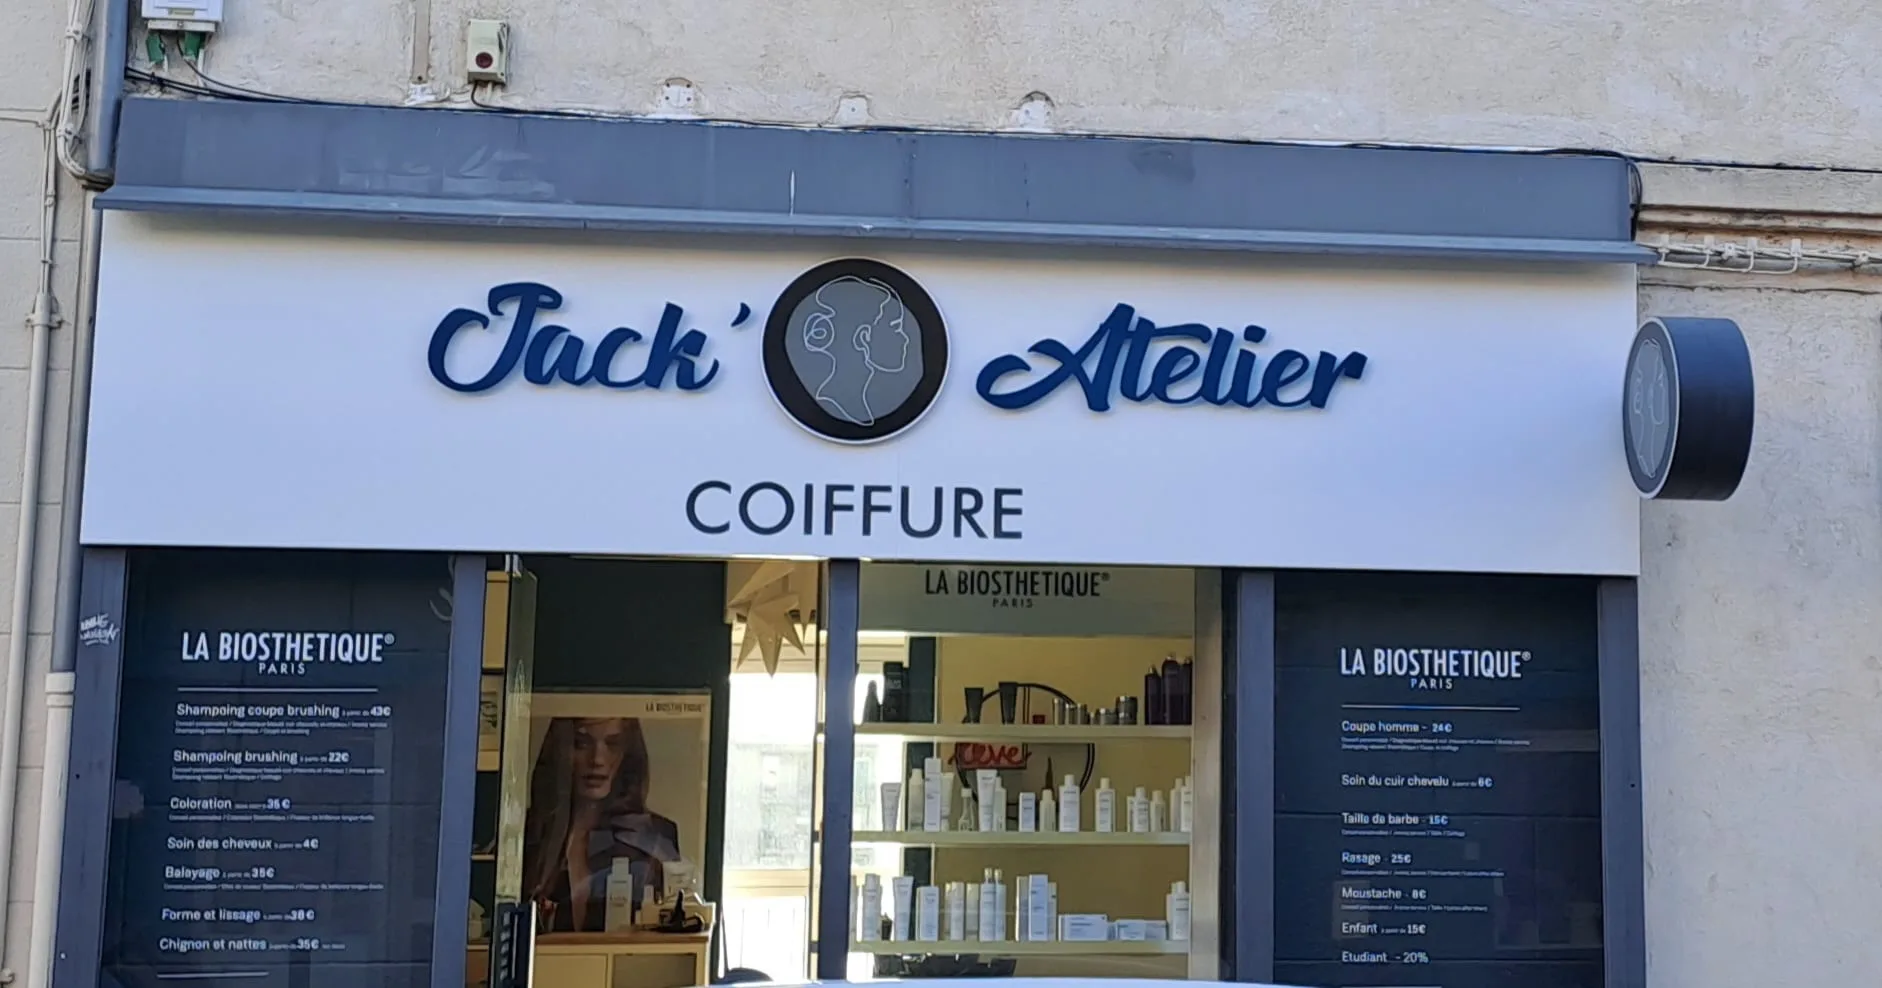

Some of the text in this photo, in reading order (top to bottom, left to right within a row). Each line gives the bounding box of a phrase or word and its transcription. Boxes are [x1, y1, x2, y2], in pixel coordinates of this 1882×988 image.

[975, 302, 1367, 414] Atelier
[686, 480, 1024, 540] COIFFURE
[925, 569, 949, 595] LA
[992, 598, 1033, 608] PARIS
[181, 632, 210, 660] LA
[258, 662, 306, 675] PARIS
[1341, 648, 1366, 675] LA
[1410, 678, 1453, 689] PARIS
[176, 703, 246, 719] Shampoing
[247, 706, 284, 718] coupe
[287, 703, 340, 719] brushing
[1341, 720, 1376, 734] Coupe
[1378, 721, 1420, 733] homme
[173, 750, 243, 765] Shampoing
[245, 750, 298, 765] brushing
[1341, 774, 1366, 786] Soin
[1368, 775, 1382, 786] du
[1384, 775, 1404, 787] cuir
[1407, 775, 1449, 787] chevelu
[170, 797, 232, 810] Coloration
[1342, 812, 1370, 825] Taille
[1372, 813, 1386, 825] de
[1388, 813, 1419, 825] barbe
[167, 837, 195, 849] Soin
[197, 837, 219, 849] des
[222, 837, 272, 849] cheveux
[1342, 852, 1381, 866] Rasage
[165, 866, 220, 881] Balayage
[1342, 887, 1402, 899] Moustache
[161, 908, 201, 921] Forme
[203, 909, 216, 921] et
[219, 908, 261, 923] lissage
[1342, 922, 1378, 934] Enfant
[1407, 924, 1426, 934] 15€
[159, 938, 210, 952] Chignon
[213, 939, 225, 950] et
[228, 938, 267, 950] nattes
[1342, 951, 1388, 963] Etudiant
